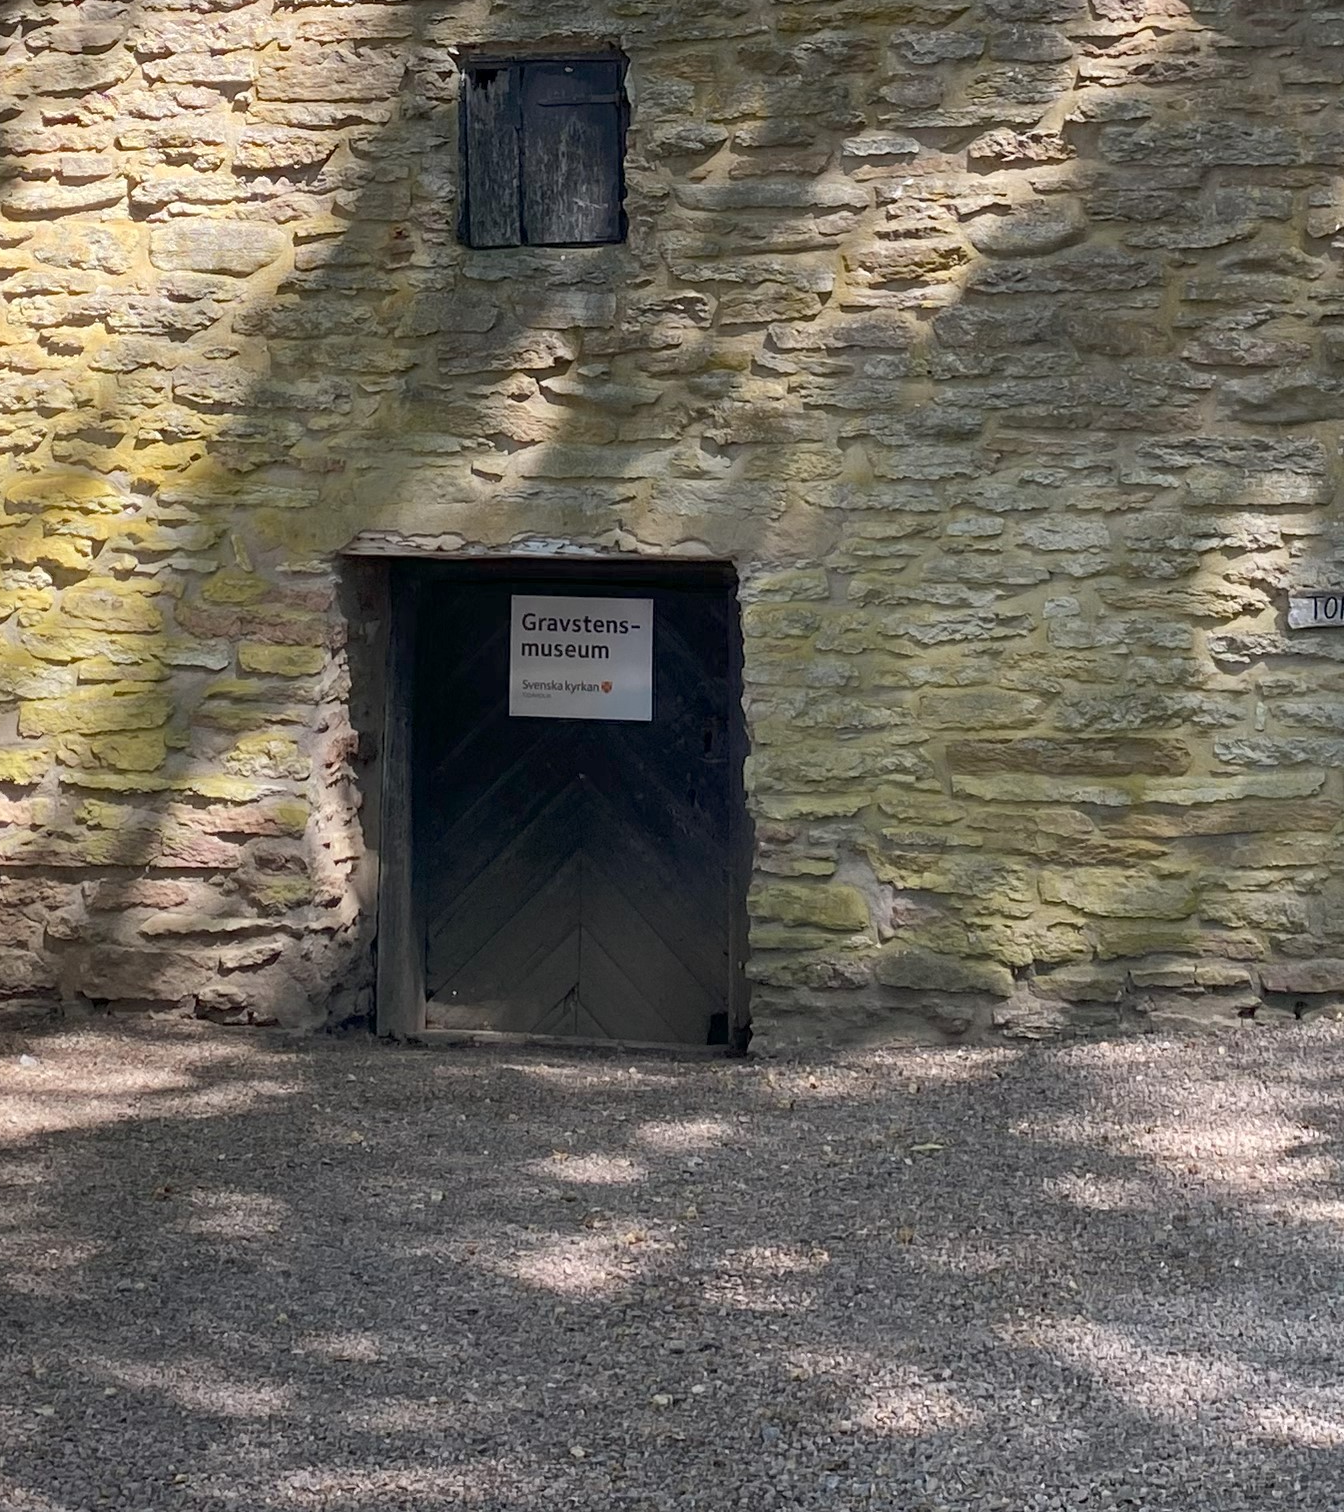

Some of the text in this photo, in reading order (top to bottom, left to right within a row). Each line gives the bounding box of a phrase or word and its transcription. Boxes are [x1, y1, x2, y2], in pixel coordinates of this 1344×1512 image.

[521, 613, 641, 635] Gravstens-
[521, 642, 610, 659] museum
[522, 679, 599, 694] Svenska kyrkan
